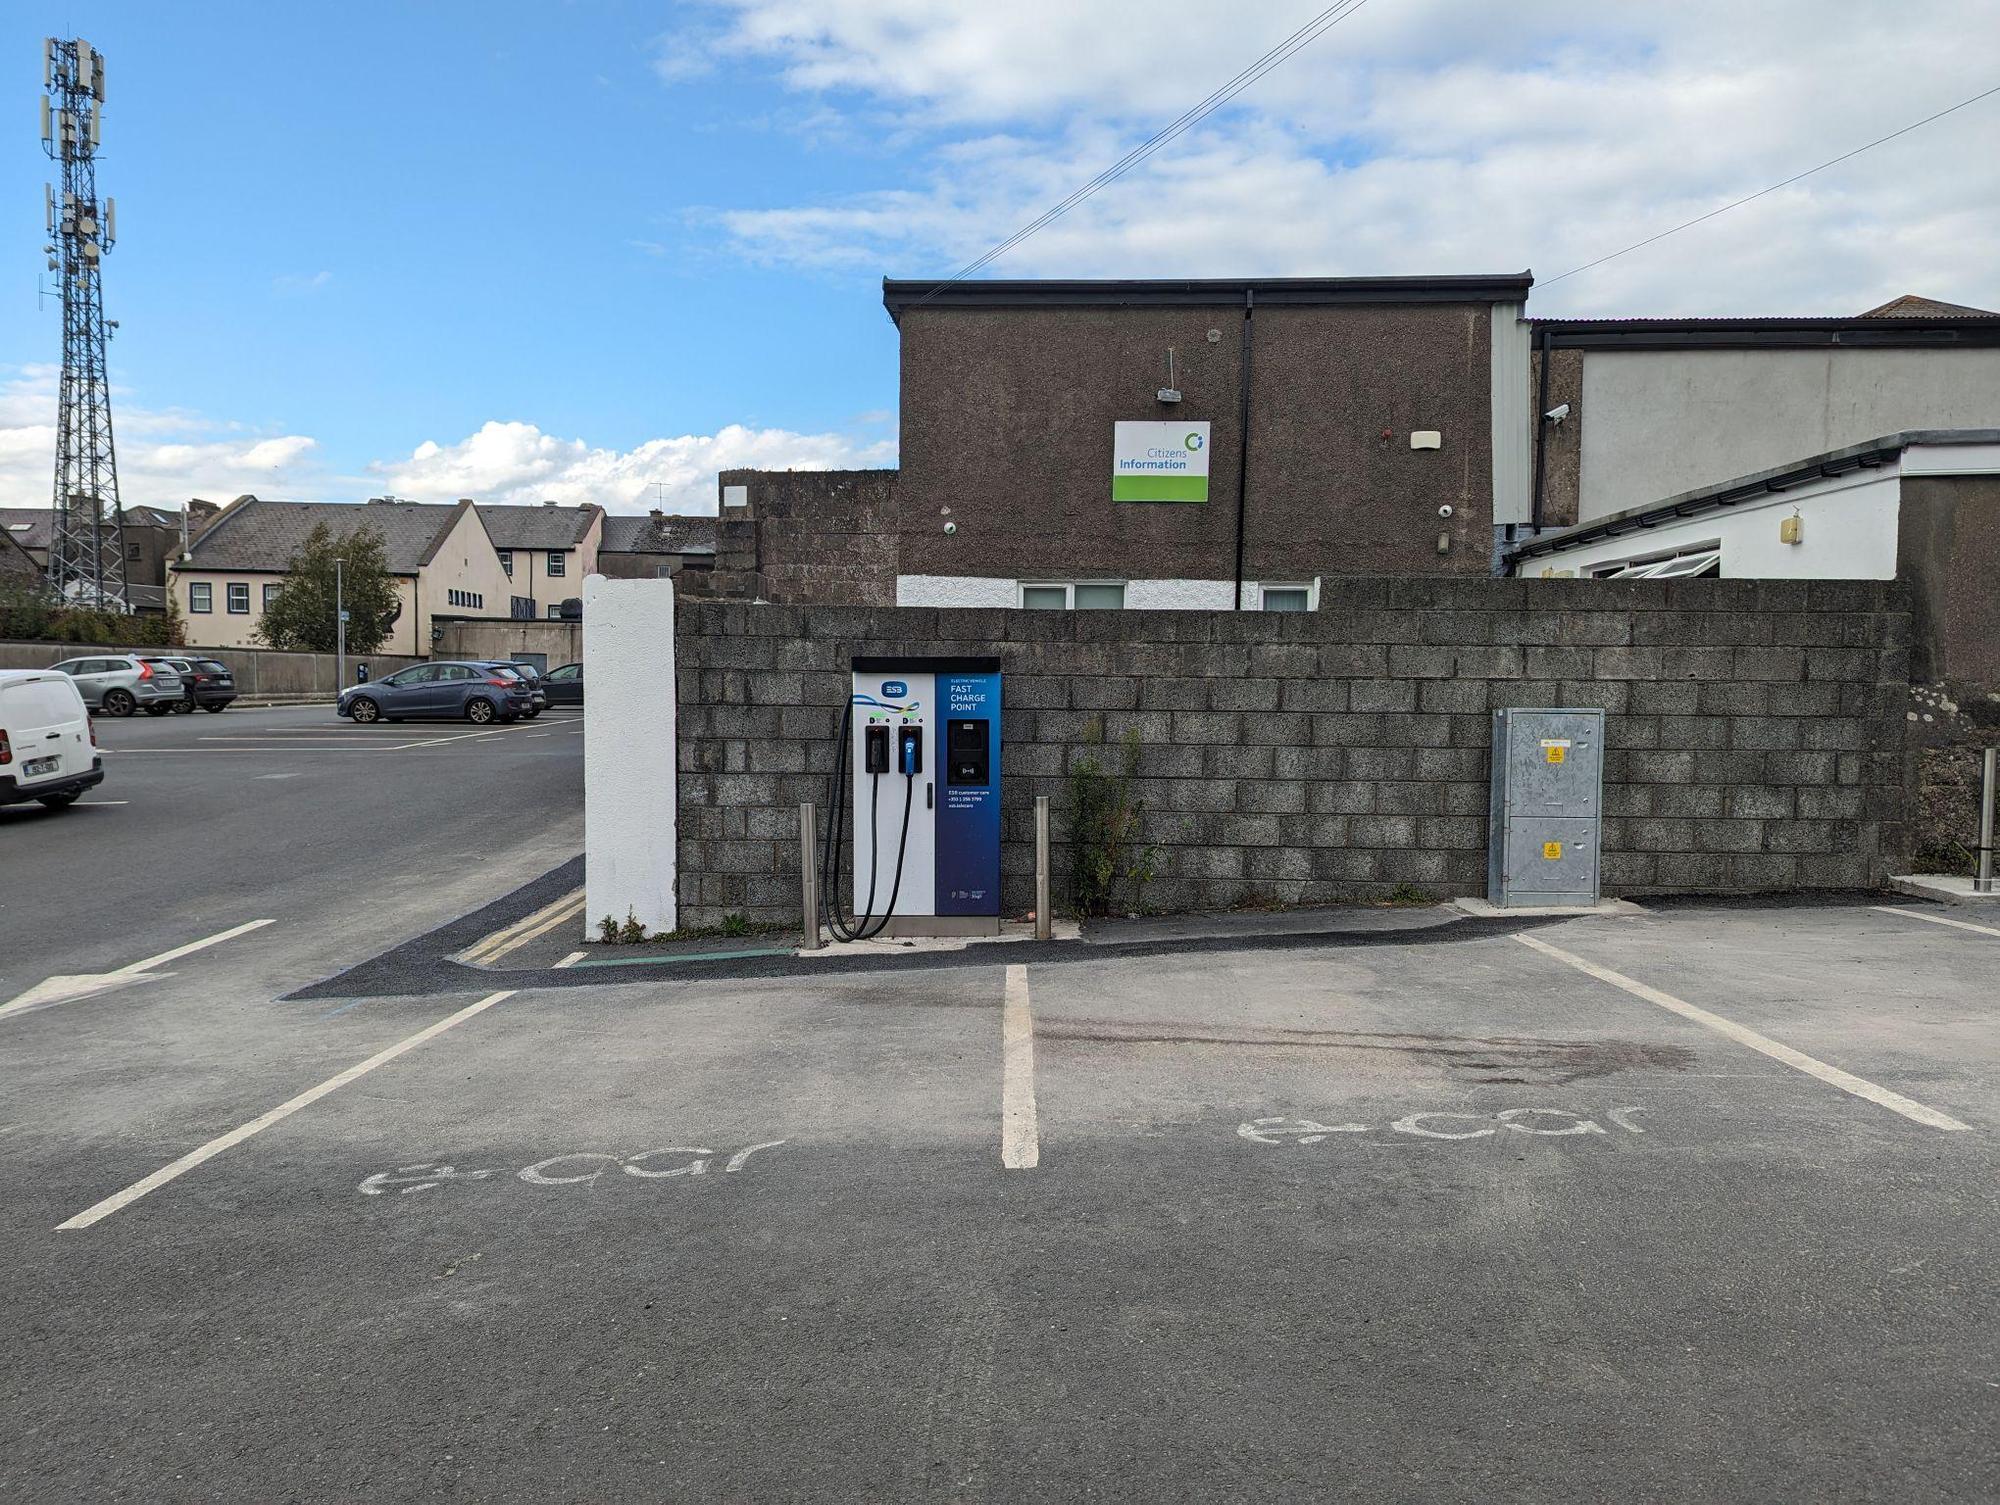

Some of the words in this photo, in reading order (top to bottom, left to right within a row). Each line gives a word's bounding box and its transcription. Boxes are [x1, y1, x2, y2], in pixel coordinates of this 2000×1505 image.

[1147, 447, 1187, 458] Citizens
[1120, 459, 1187, 470] Information
[886, 686, 903, 694] ESB
[950, 685, 972, 693] FAST
[950, 694, 986, 702] CHARGE
[950, 703, 977, 711] POINT
